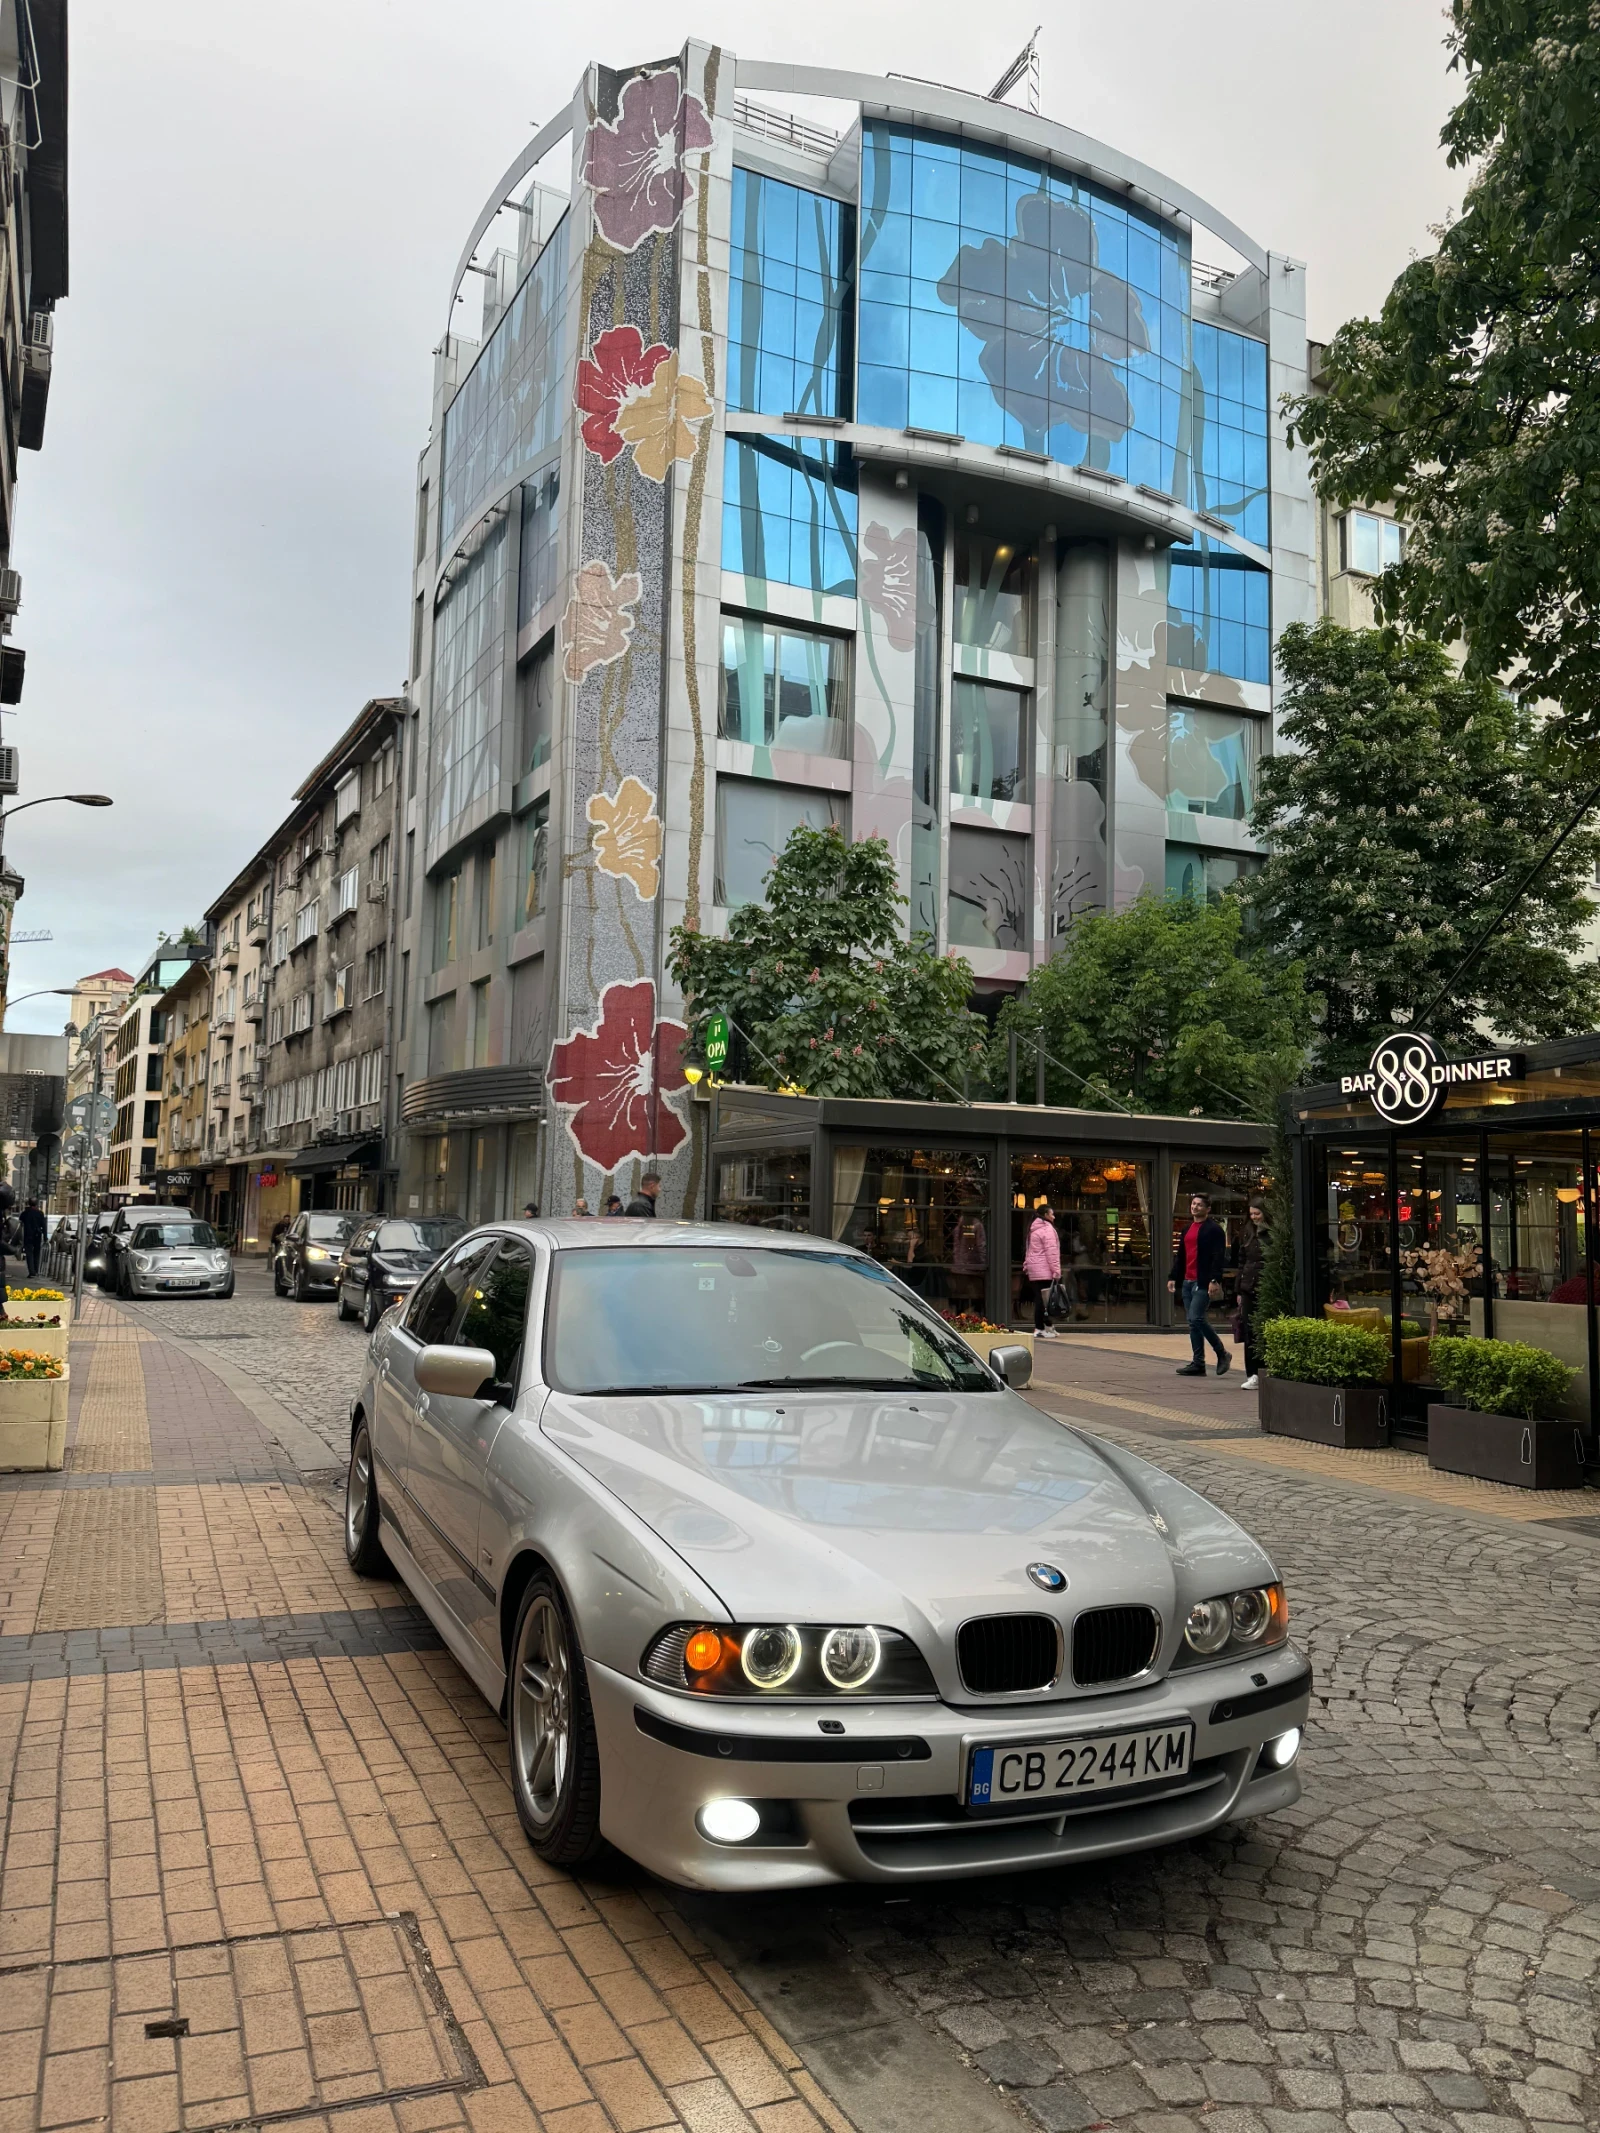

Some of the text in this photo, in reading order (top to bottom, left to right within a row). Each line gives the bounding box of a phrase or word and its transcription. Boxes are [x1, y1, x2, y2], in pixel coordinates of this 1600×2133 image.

[707, 1040, 726, 1058] OPA
[1341, 1073, 1376, 1094] BAR
[1431, 1058, 1512, 1084] DINNER
[1000, 1731, 1186, 1794] CB 2244 KM
[973, 1783, 990, 1796] BG
